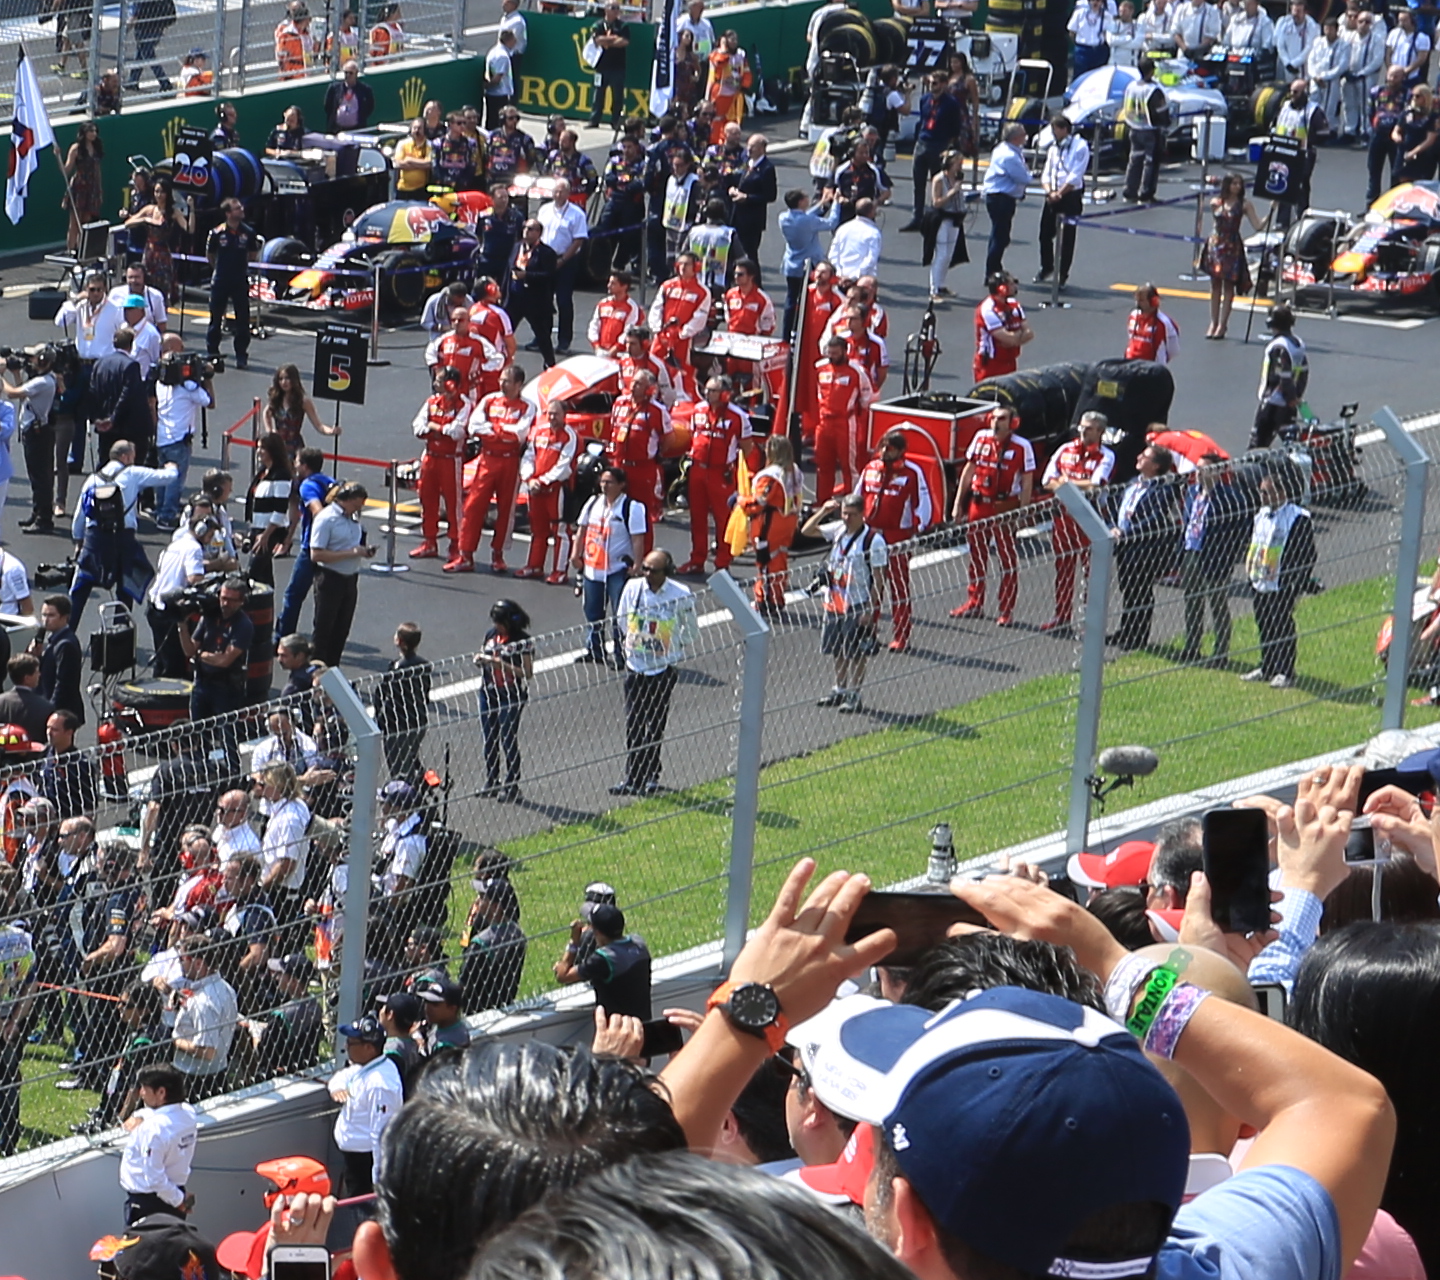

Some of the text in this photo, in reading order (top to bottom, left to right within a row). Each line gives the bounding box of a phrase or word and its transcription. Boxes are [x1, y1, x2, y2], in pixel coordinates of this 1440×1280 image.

[906, 40, 946, 66] 77
[1265, 161, 1289, 195] 3
[327, 353, 352, 391] 5
